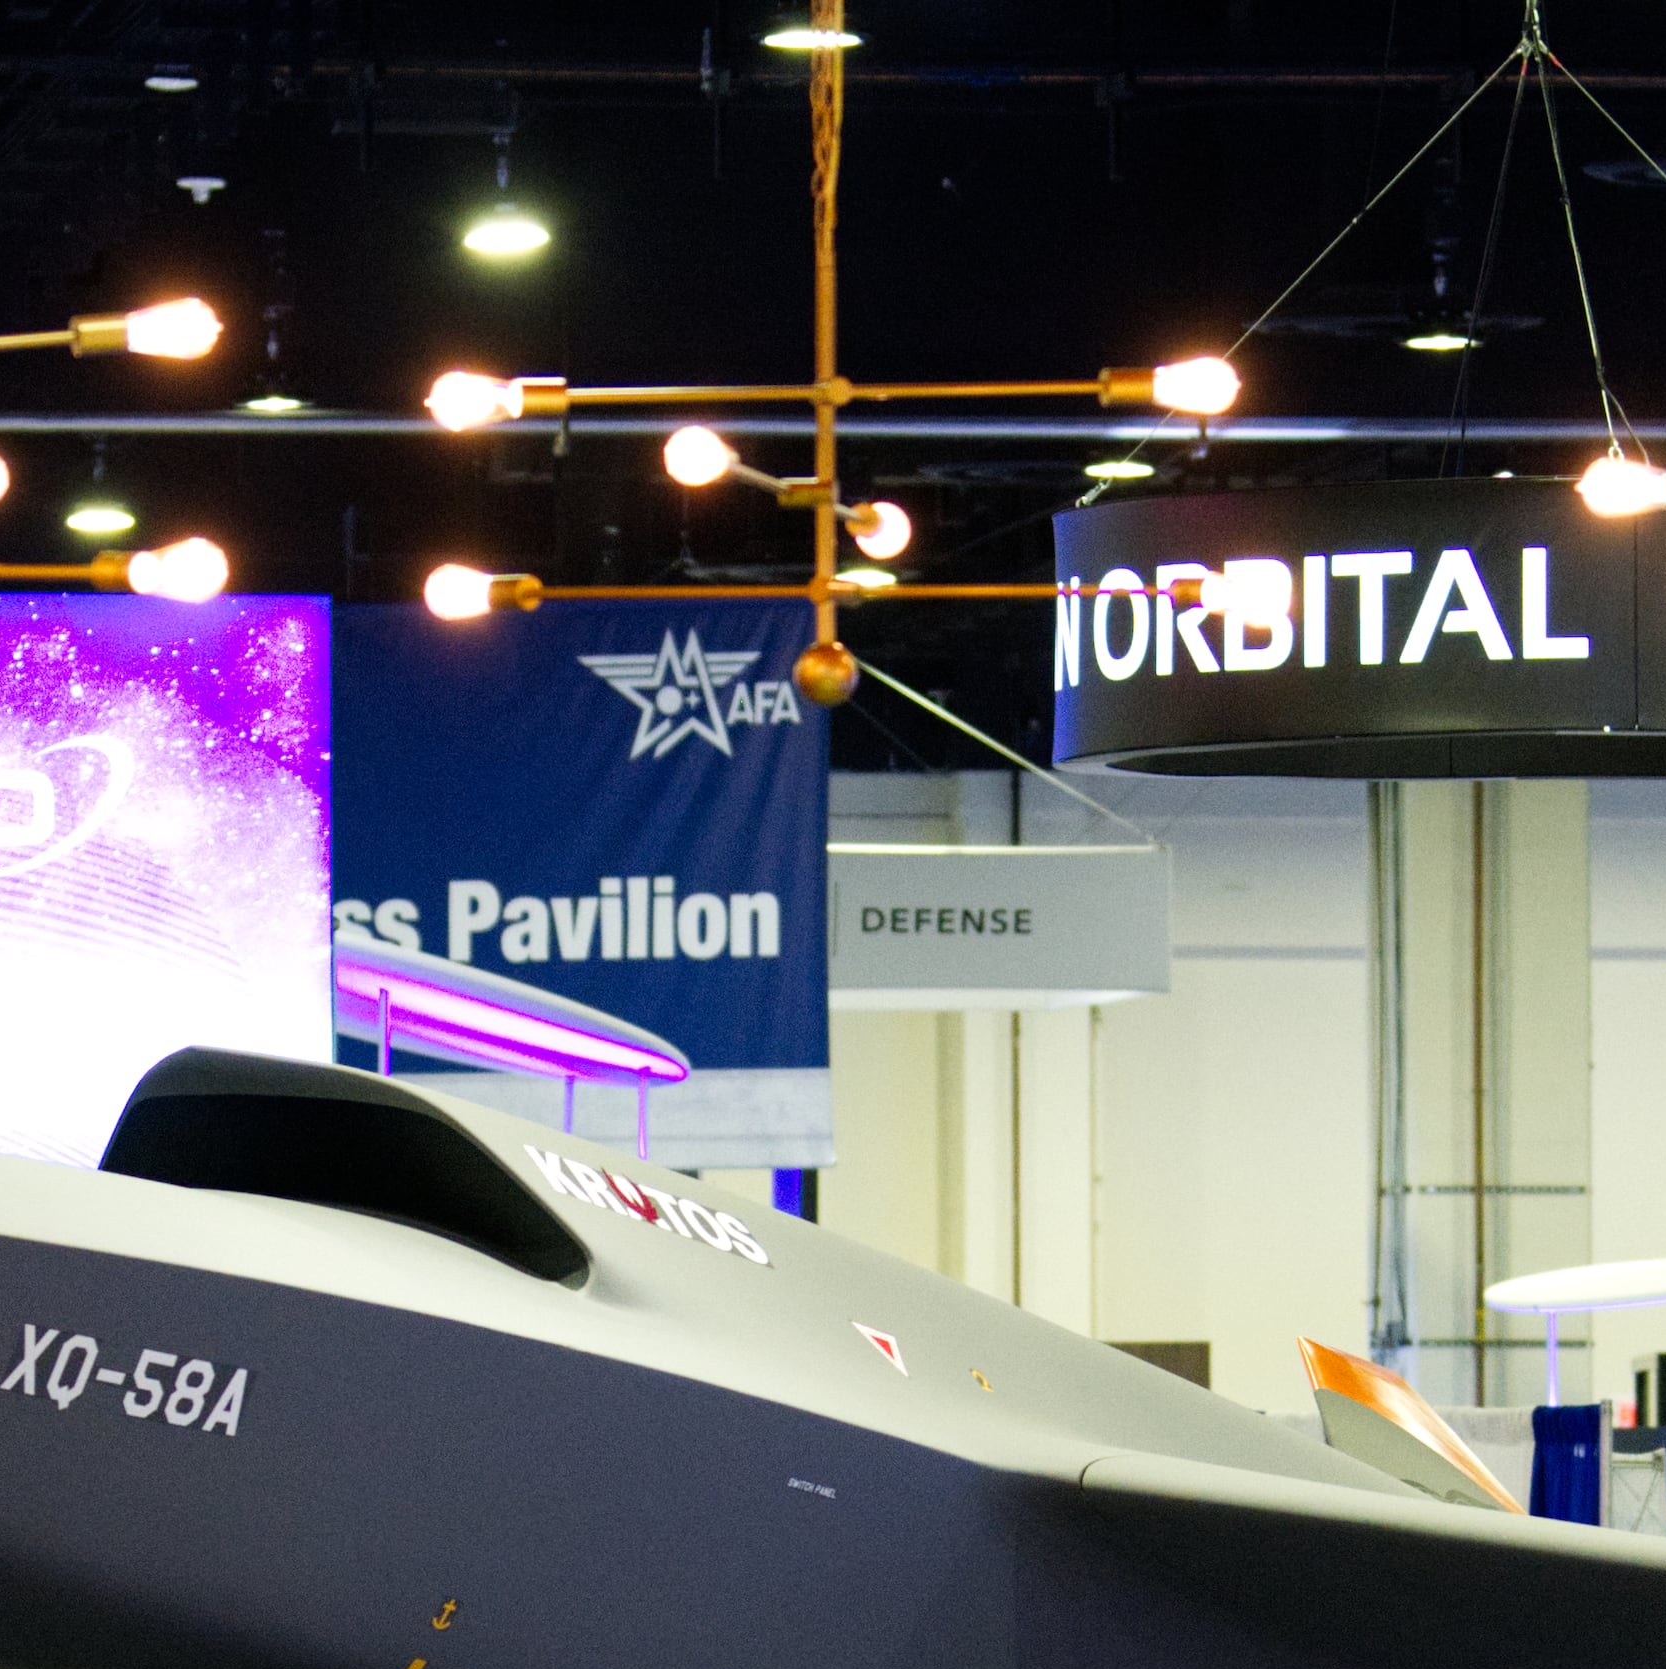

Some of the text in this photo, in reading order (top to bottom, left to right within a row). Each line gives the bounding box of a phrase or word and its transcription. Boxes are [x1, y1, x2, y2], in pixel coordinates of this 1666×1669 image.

[1094, 547, 1589, 681] ORBITAL
[727, 681, 801, 725] AFA
[448, 876, 779, 963] Pavilion
[862, 907, 1032, 934] DEFENSE
[0, 1323, 248, 1437] XQ-58A
